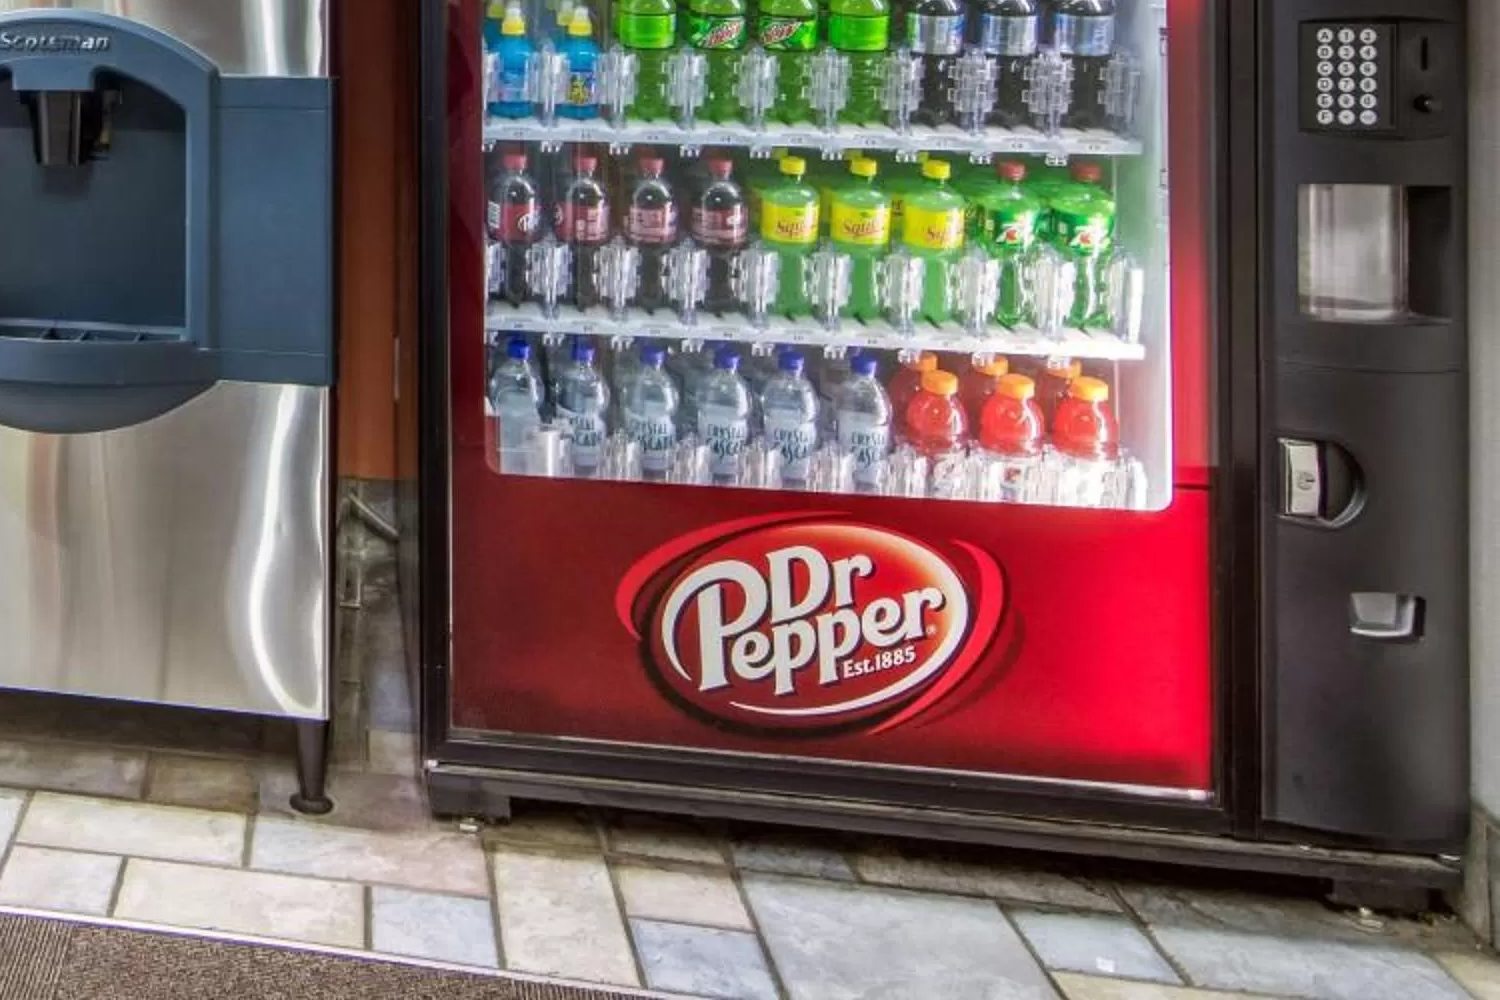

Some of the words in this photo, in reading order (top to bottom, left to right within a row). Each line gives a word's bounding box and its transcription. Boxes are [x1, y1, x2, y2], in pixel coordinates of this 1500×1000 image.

[0, 31, 110, 50] Scotsman
[766, 545, 874, 623] Dr
[662, 560, 946, 696] Pepper
